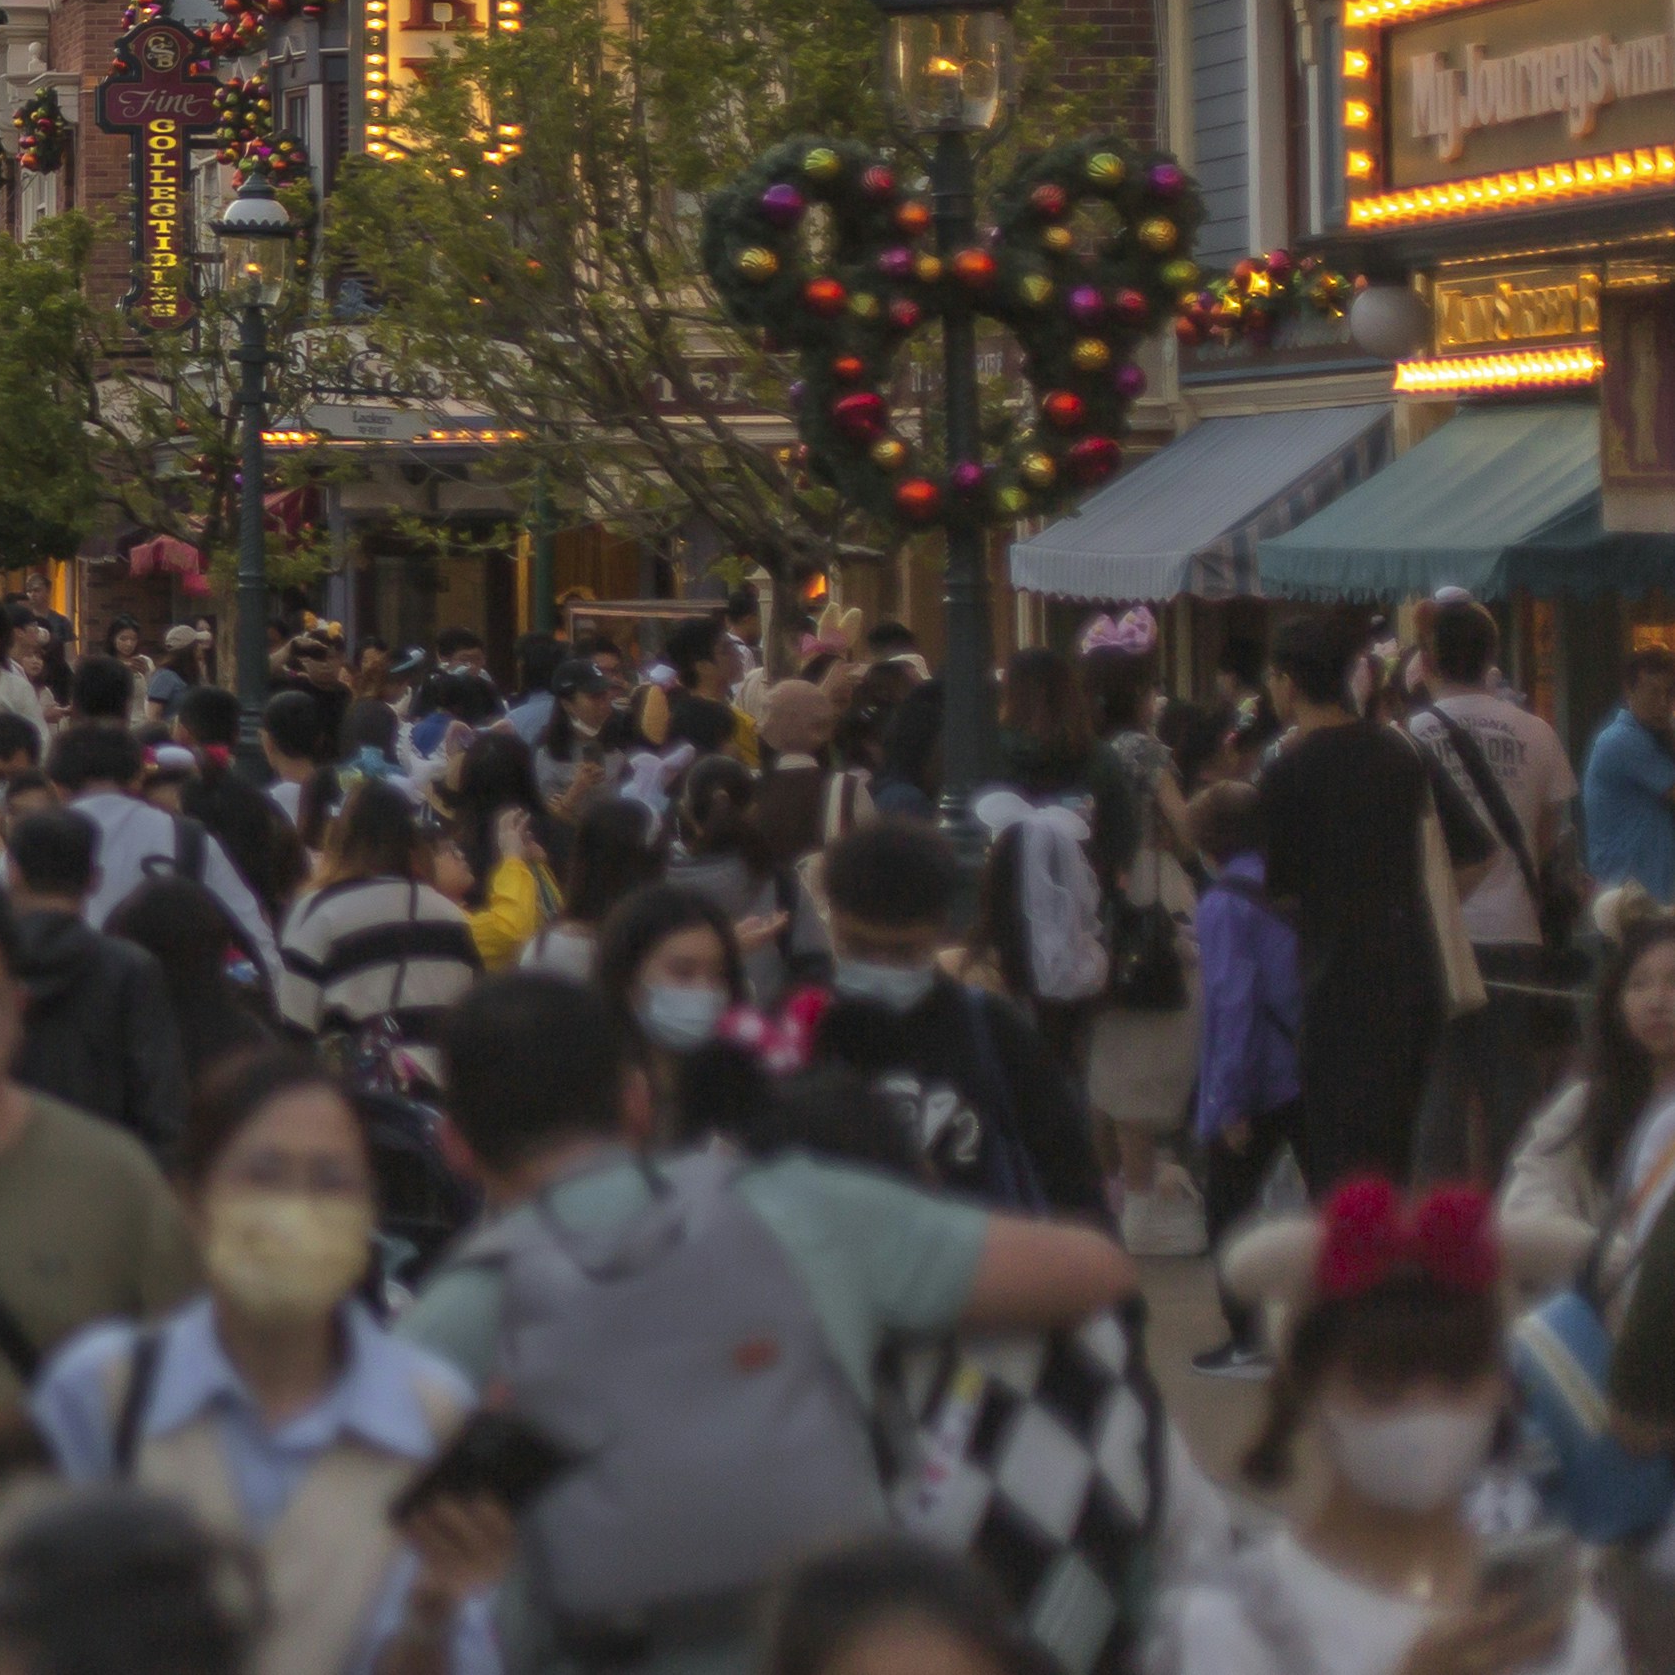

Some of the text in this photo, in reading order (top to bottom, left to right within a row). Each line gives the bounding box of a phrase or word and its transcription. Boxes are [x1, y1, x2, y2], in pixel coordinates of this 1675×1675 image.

[118, 88, 210, 118] Fine
[1412, 52, 1465, 162] My
[1460, 36, 1615, 136] Journeys
